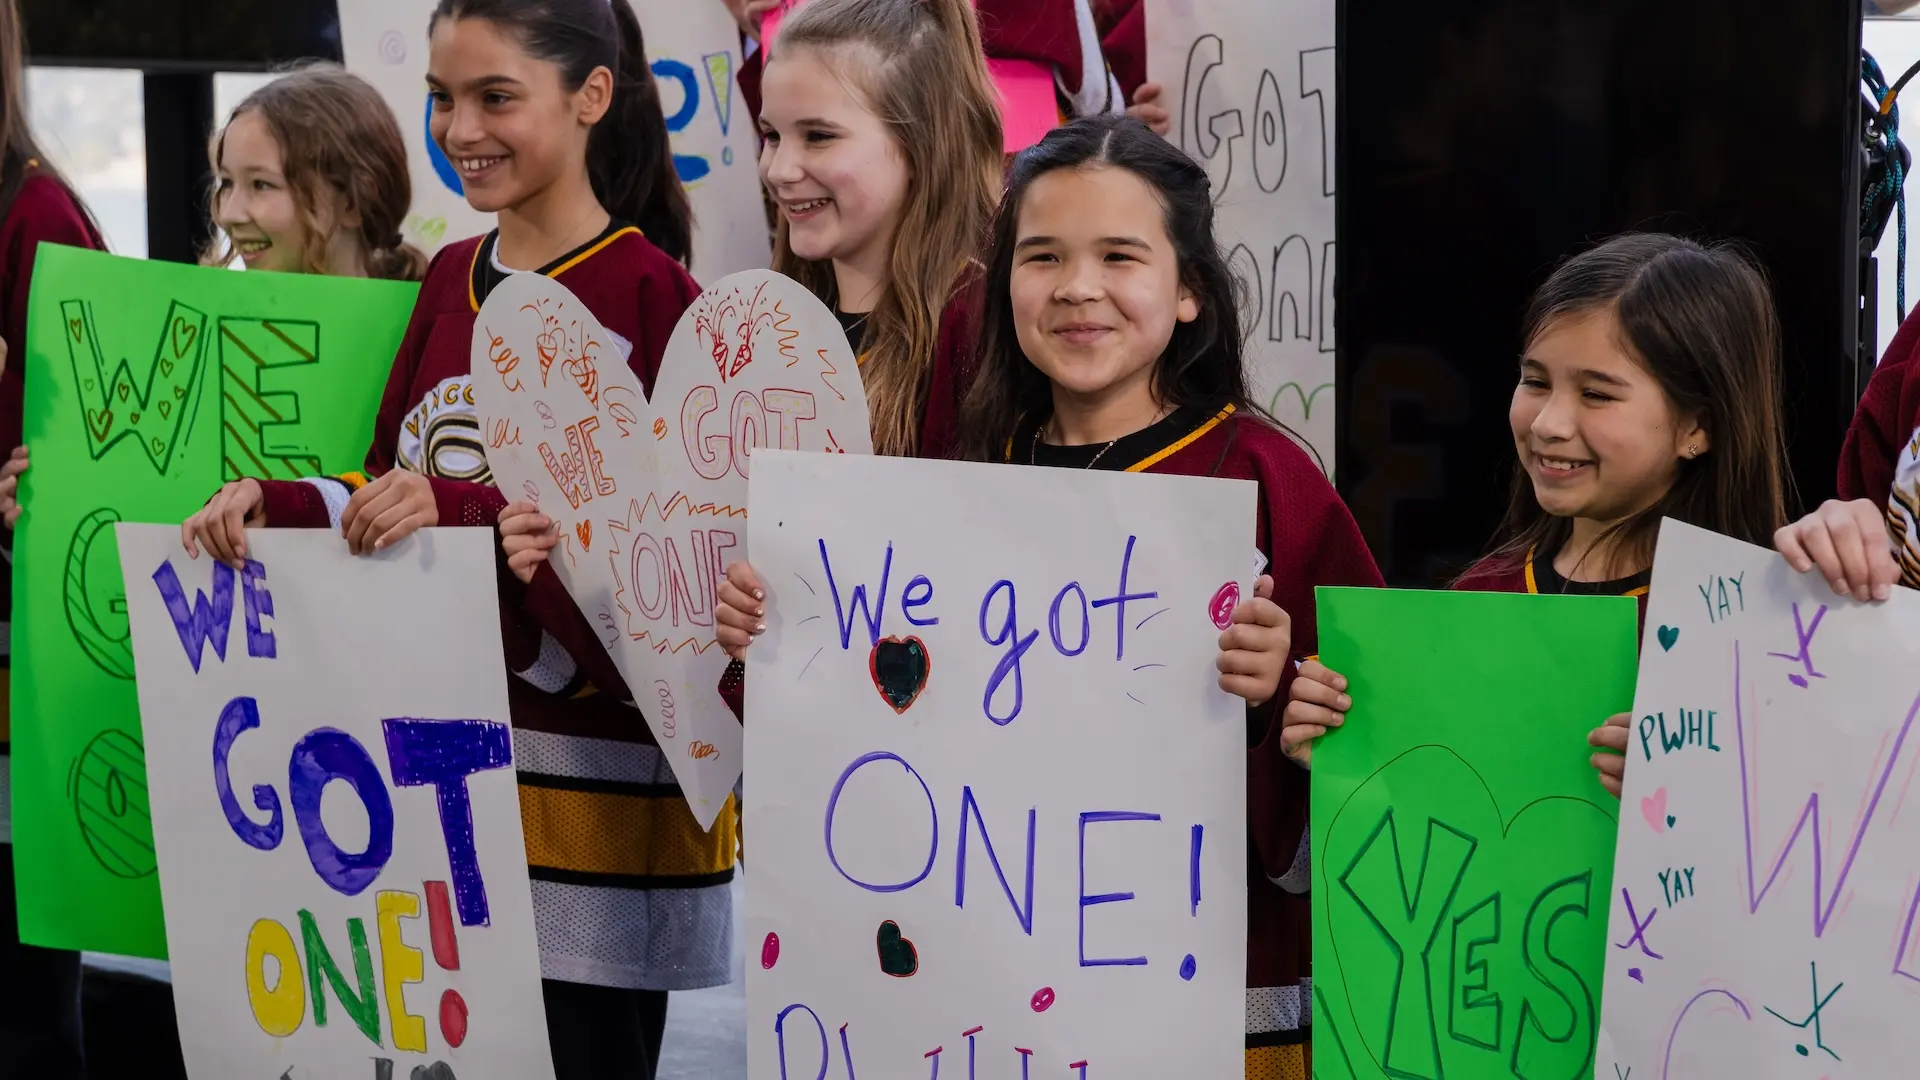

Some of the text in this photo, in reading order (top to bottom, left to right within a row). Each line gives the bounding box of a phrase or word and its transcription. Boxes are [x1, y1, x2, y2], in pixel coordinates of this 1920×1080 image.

[60, 299, 323, 482] WE
[538, 385, 816, 509] WE GOT
[152, 555, 277, 675] WE
[818, 535, 1158, 725] We got
[1699, 571, 1745, 623] YAY
[213, 697, 512, 927] GOT
[1639, 708, 1720, 762] PWHL
[825, 751, 1203, 981] ONE!
[1338, 806, 1596, 1080] YES
[1658, 867, 1694, 908] YAY
[246, 879, 469, 1054] ONE!
